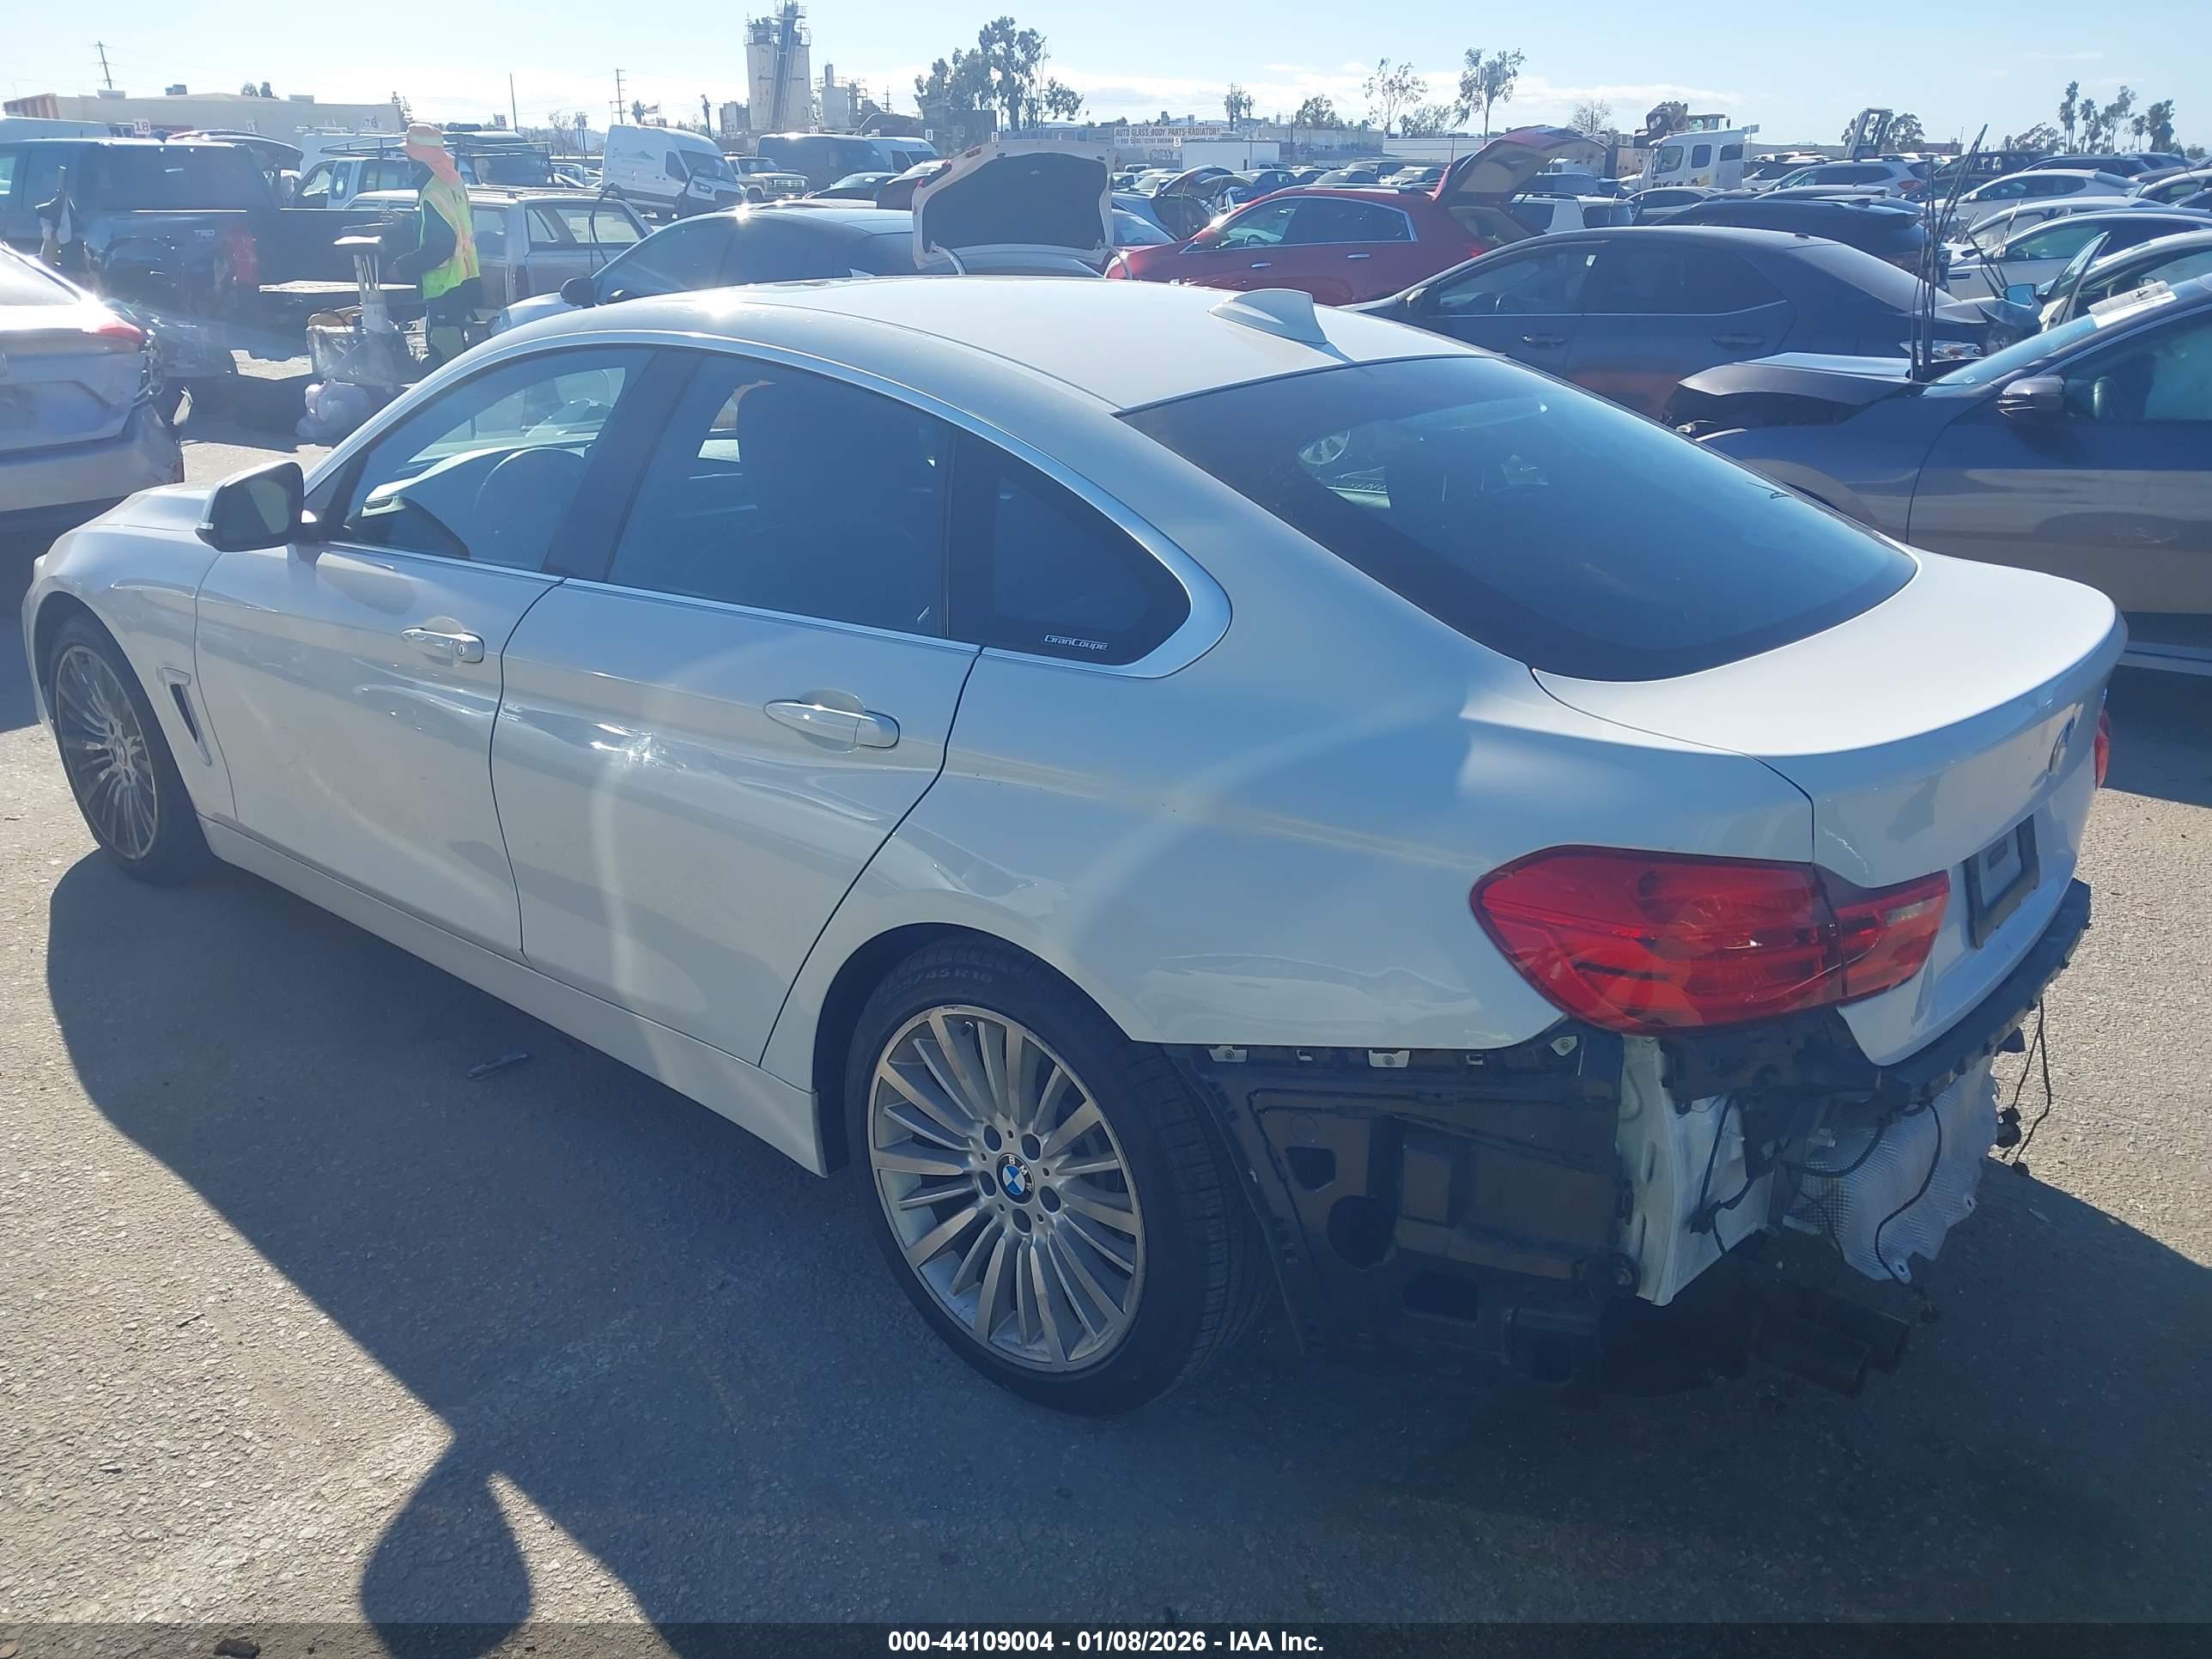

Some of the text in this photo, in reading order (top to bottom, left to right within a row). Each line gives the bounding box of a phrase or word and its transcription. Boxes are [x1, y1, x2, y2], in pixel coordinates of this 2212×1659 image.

[135, 122, 149, 131] 18
[927, 131, 932, 140] 9
[1115, 129, 1130, 137] AUTO
[1008, 1156, 1033, 1193] BMW
